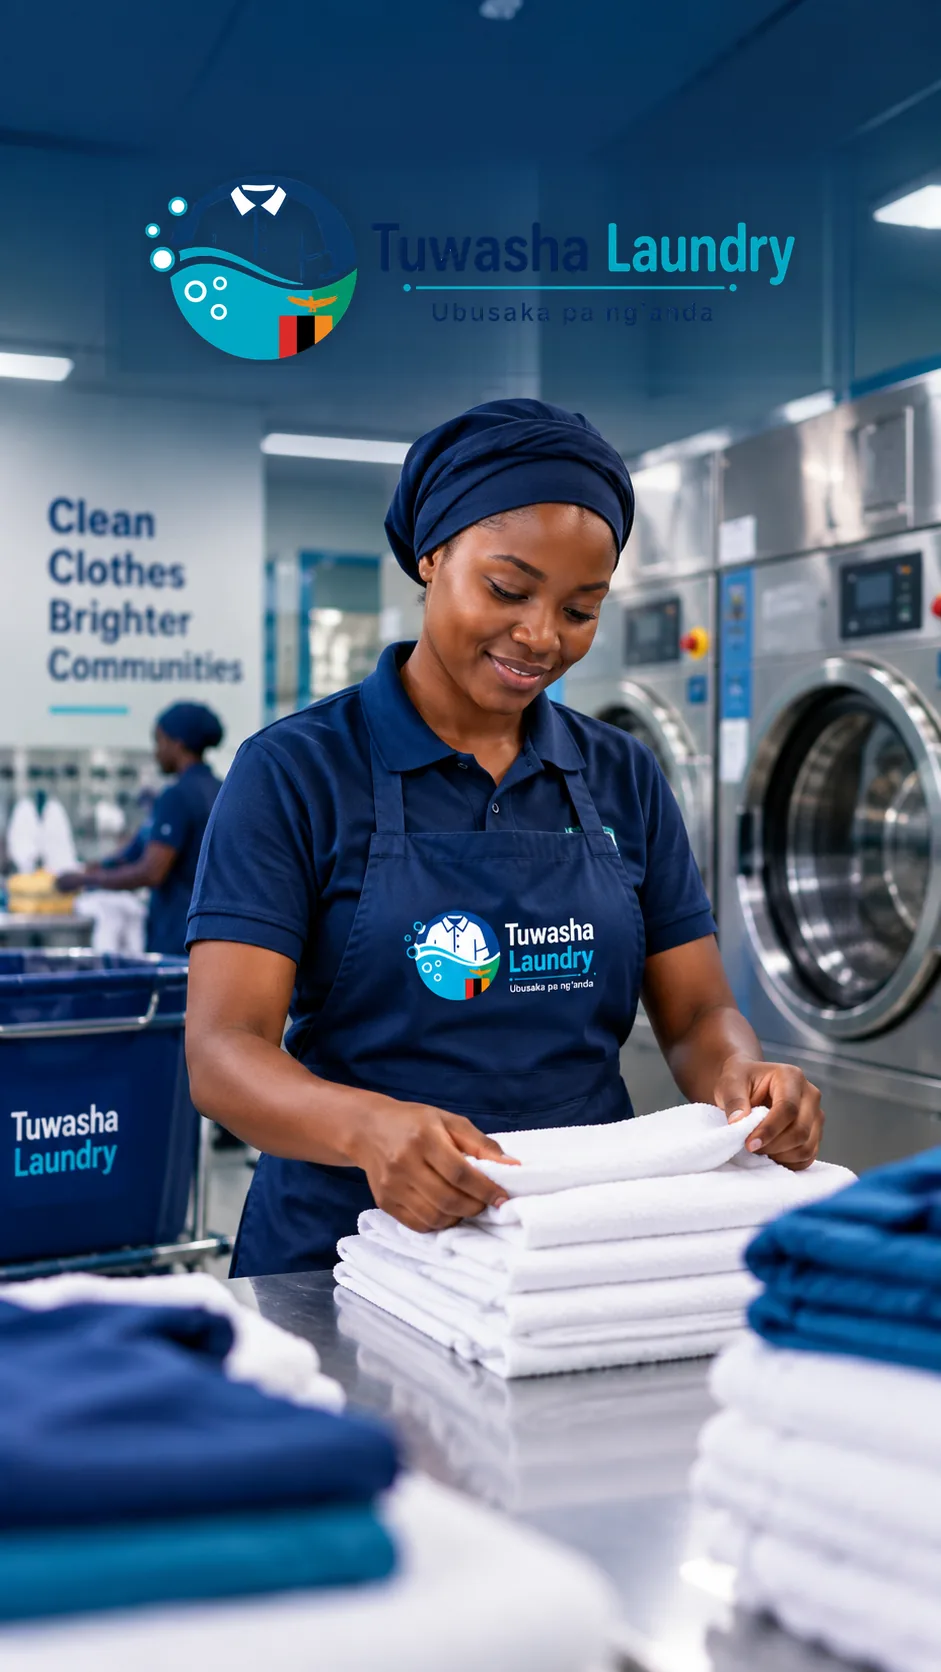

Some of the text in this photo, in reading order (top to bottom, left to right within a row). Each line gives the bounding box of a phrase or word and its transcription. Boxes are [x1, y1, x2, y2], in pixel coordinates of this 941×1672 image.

[47, 497, 156, 538] Clean
[47, 547, 187, 590] Clothes
[48, 598, 193, 645] Brighter
[47, 647, 243, 683] Communities
[505, 917, 594, 946] Tuwasha
[509, 945, 594, 974] Laundry
[10, 1103, 118, 1141] Tuwasha
[14, 1138, 118, 1177] Laundry
